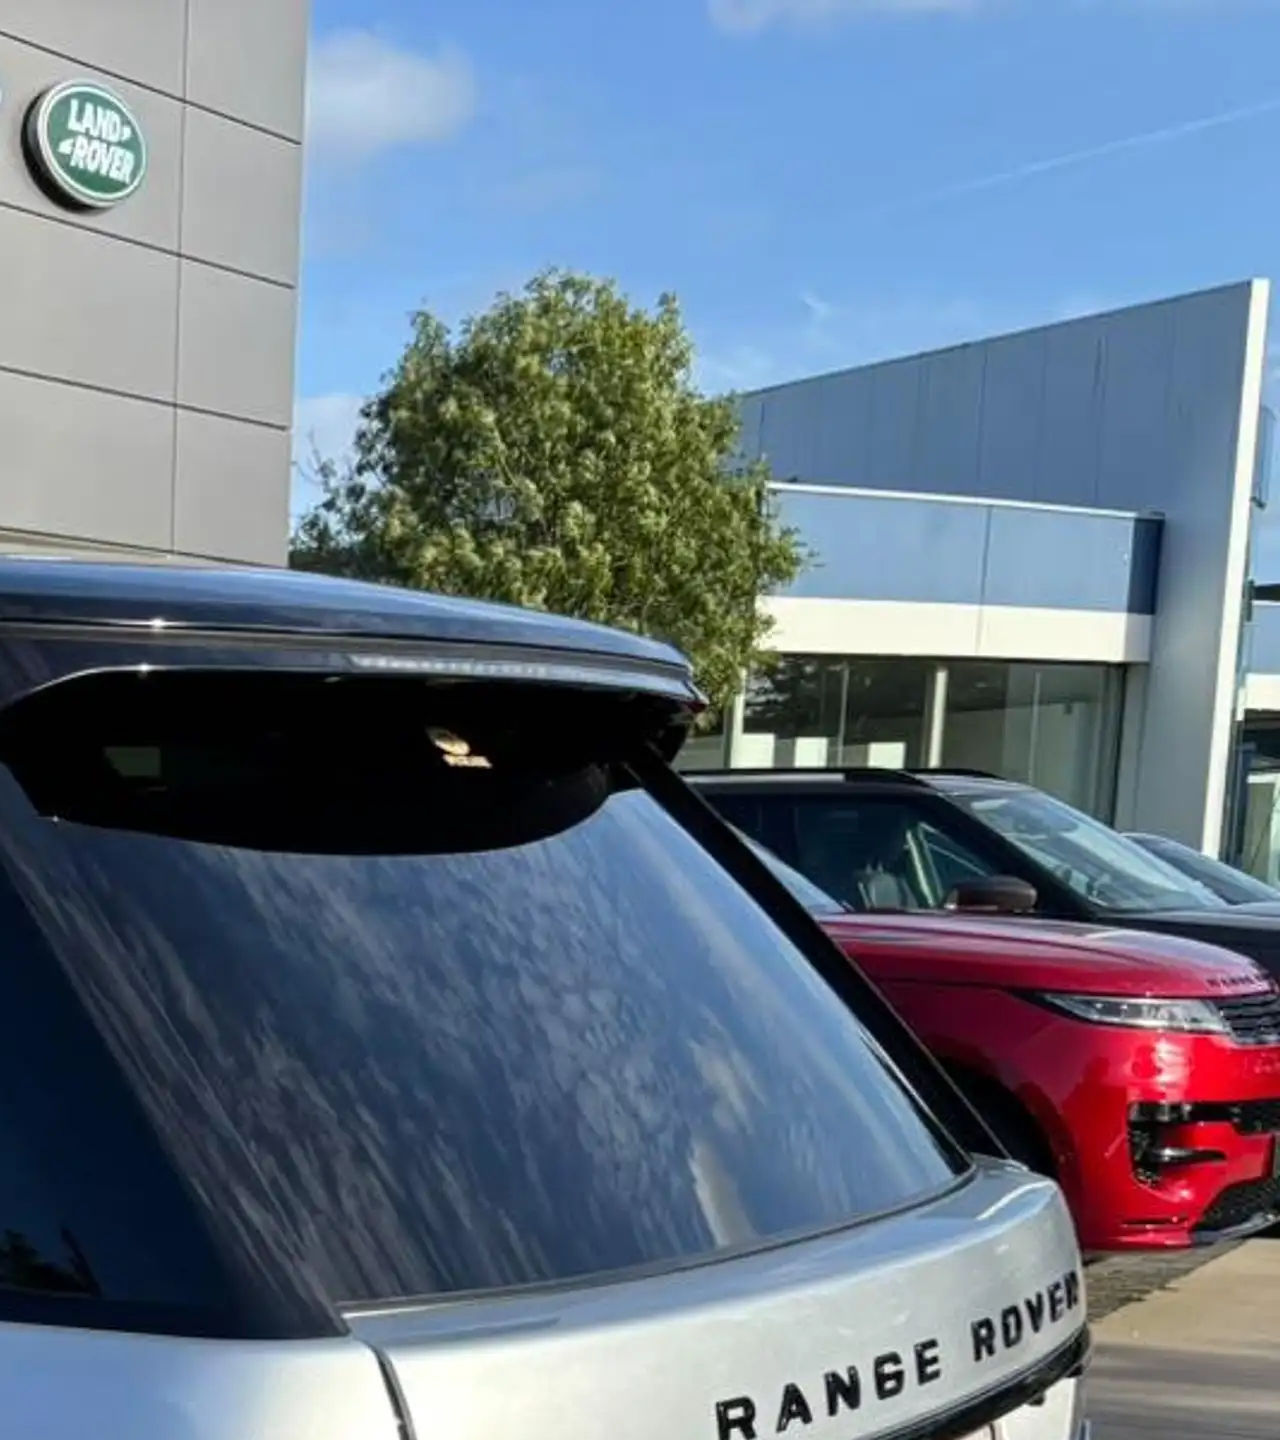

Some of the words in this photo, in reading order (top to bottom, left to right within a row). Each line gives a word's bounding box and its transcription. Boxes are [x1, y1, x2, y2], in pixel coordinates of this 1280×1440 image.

[67, 99, 122, 143] LAND
[69, 134, 135, 184] ROVER
[970, 1270, 1080, 1362] ROVER
